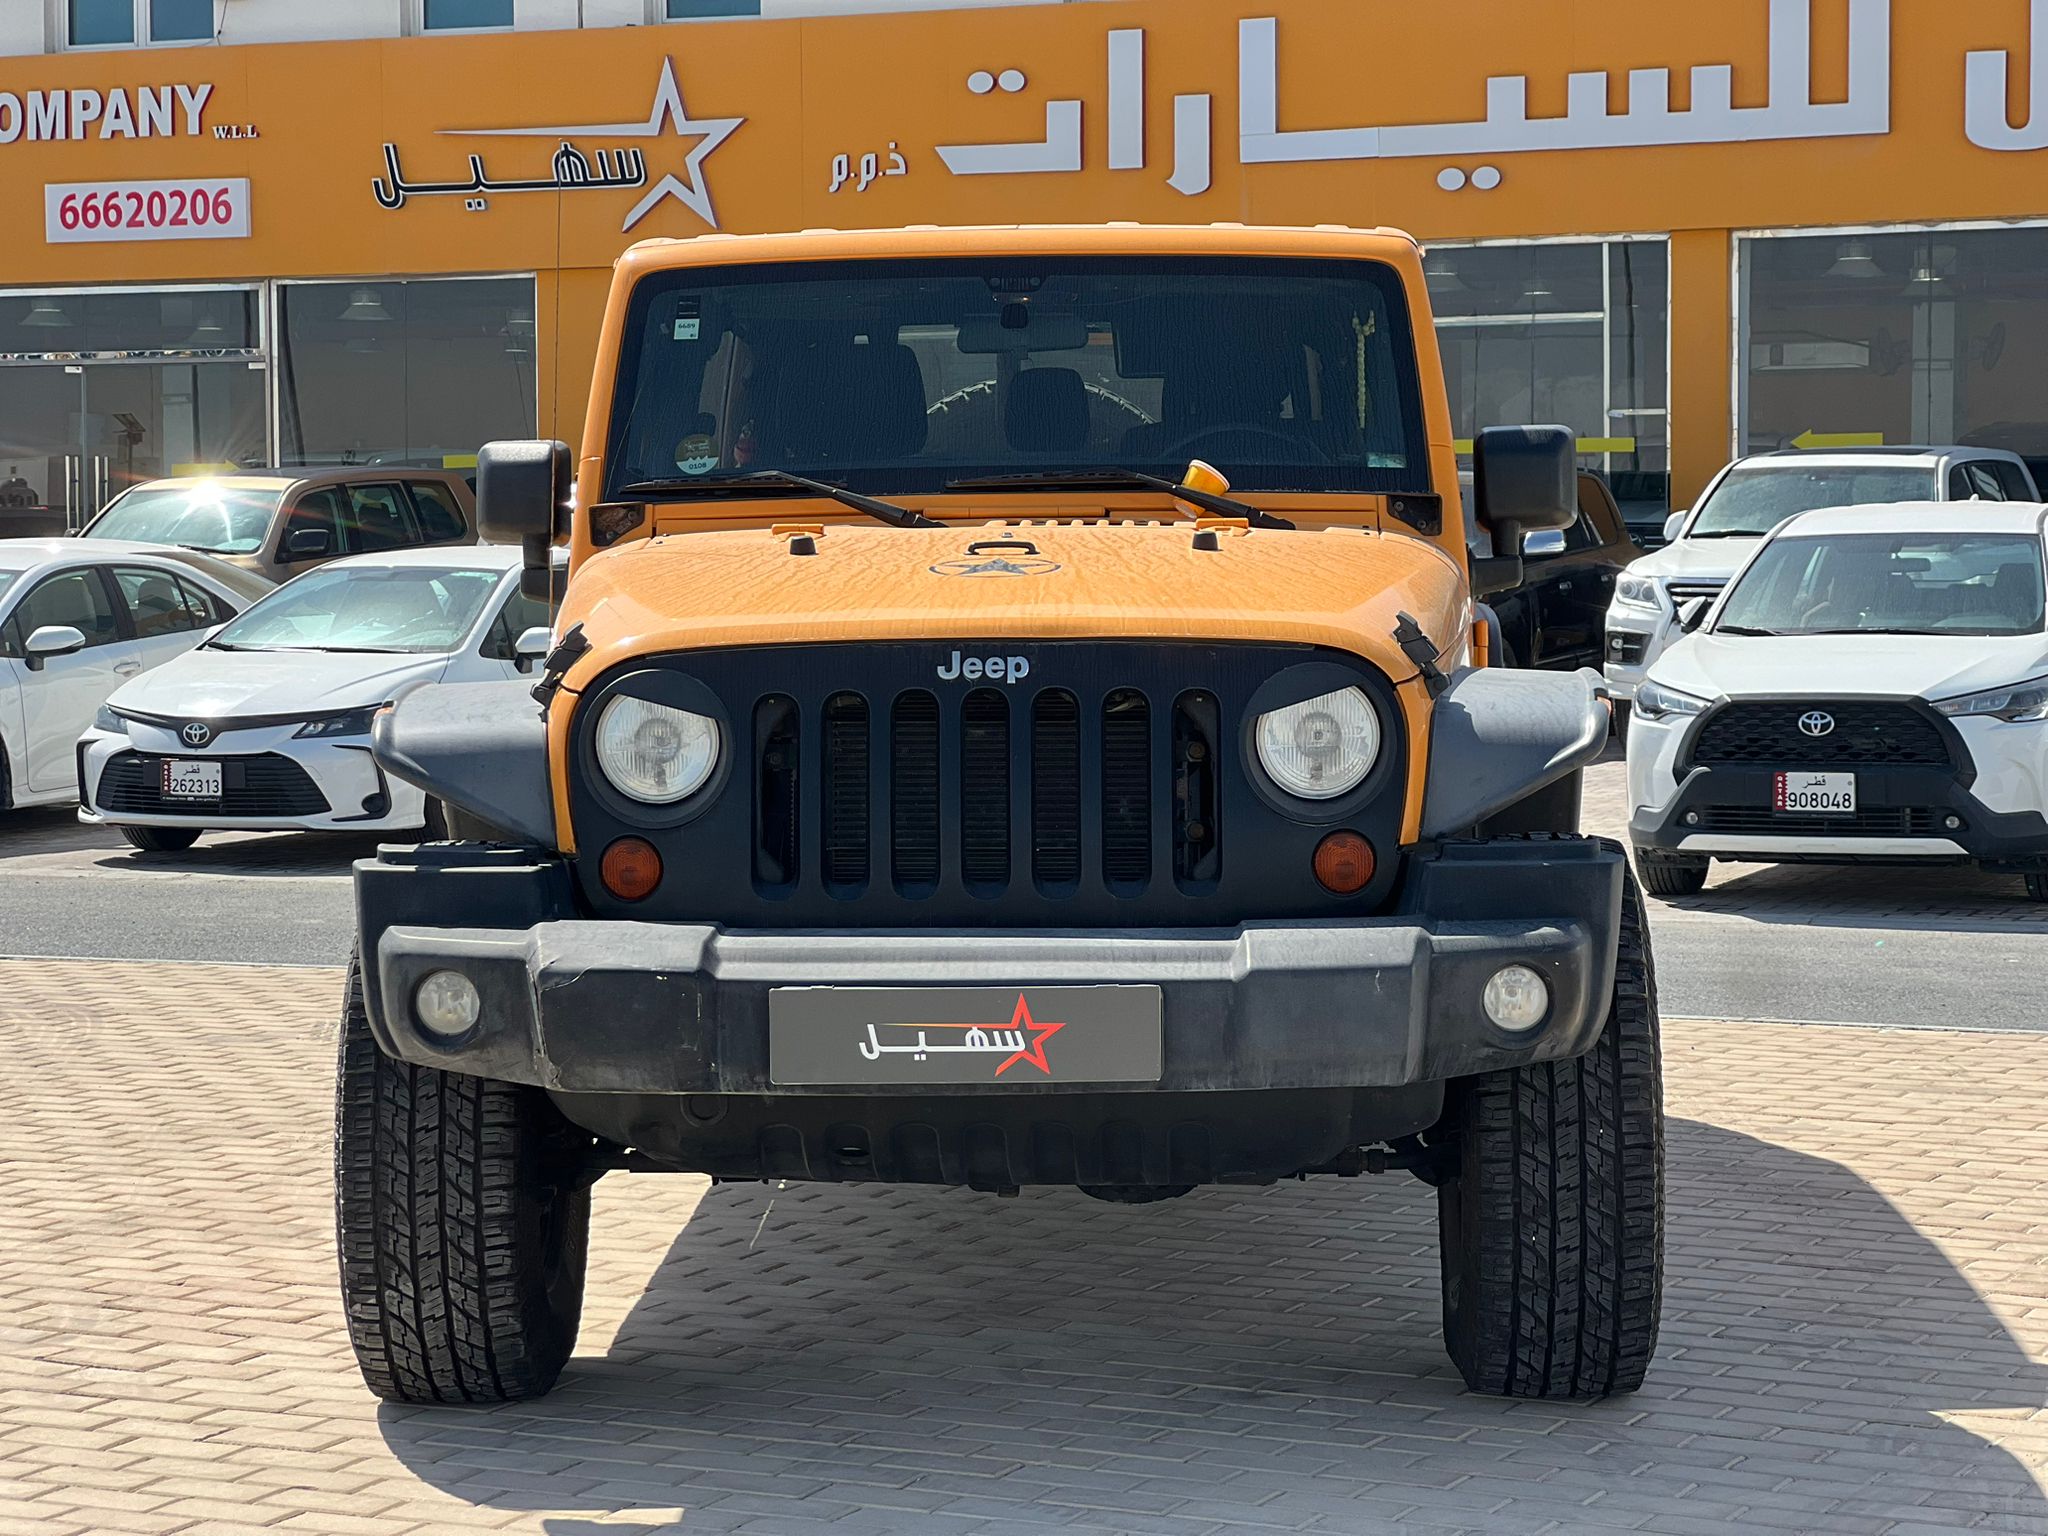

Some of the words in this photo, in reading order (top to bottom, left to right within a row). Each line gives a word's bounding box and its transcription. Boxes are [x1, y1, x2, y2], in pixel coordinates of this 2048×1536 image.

[371, 142, 648, 211] سهيل
[59, 187, 233, 230] 66620206
[936, 650, 1030, 684] Jeep
[172, 778, 220, 794] 262313
[1802, 775, 1827, 789] قطر
[1788, 792, 1852, 809] 908048
[858, 1023, 1026, 1061] سهيل
